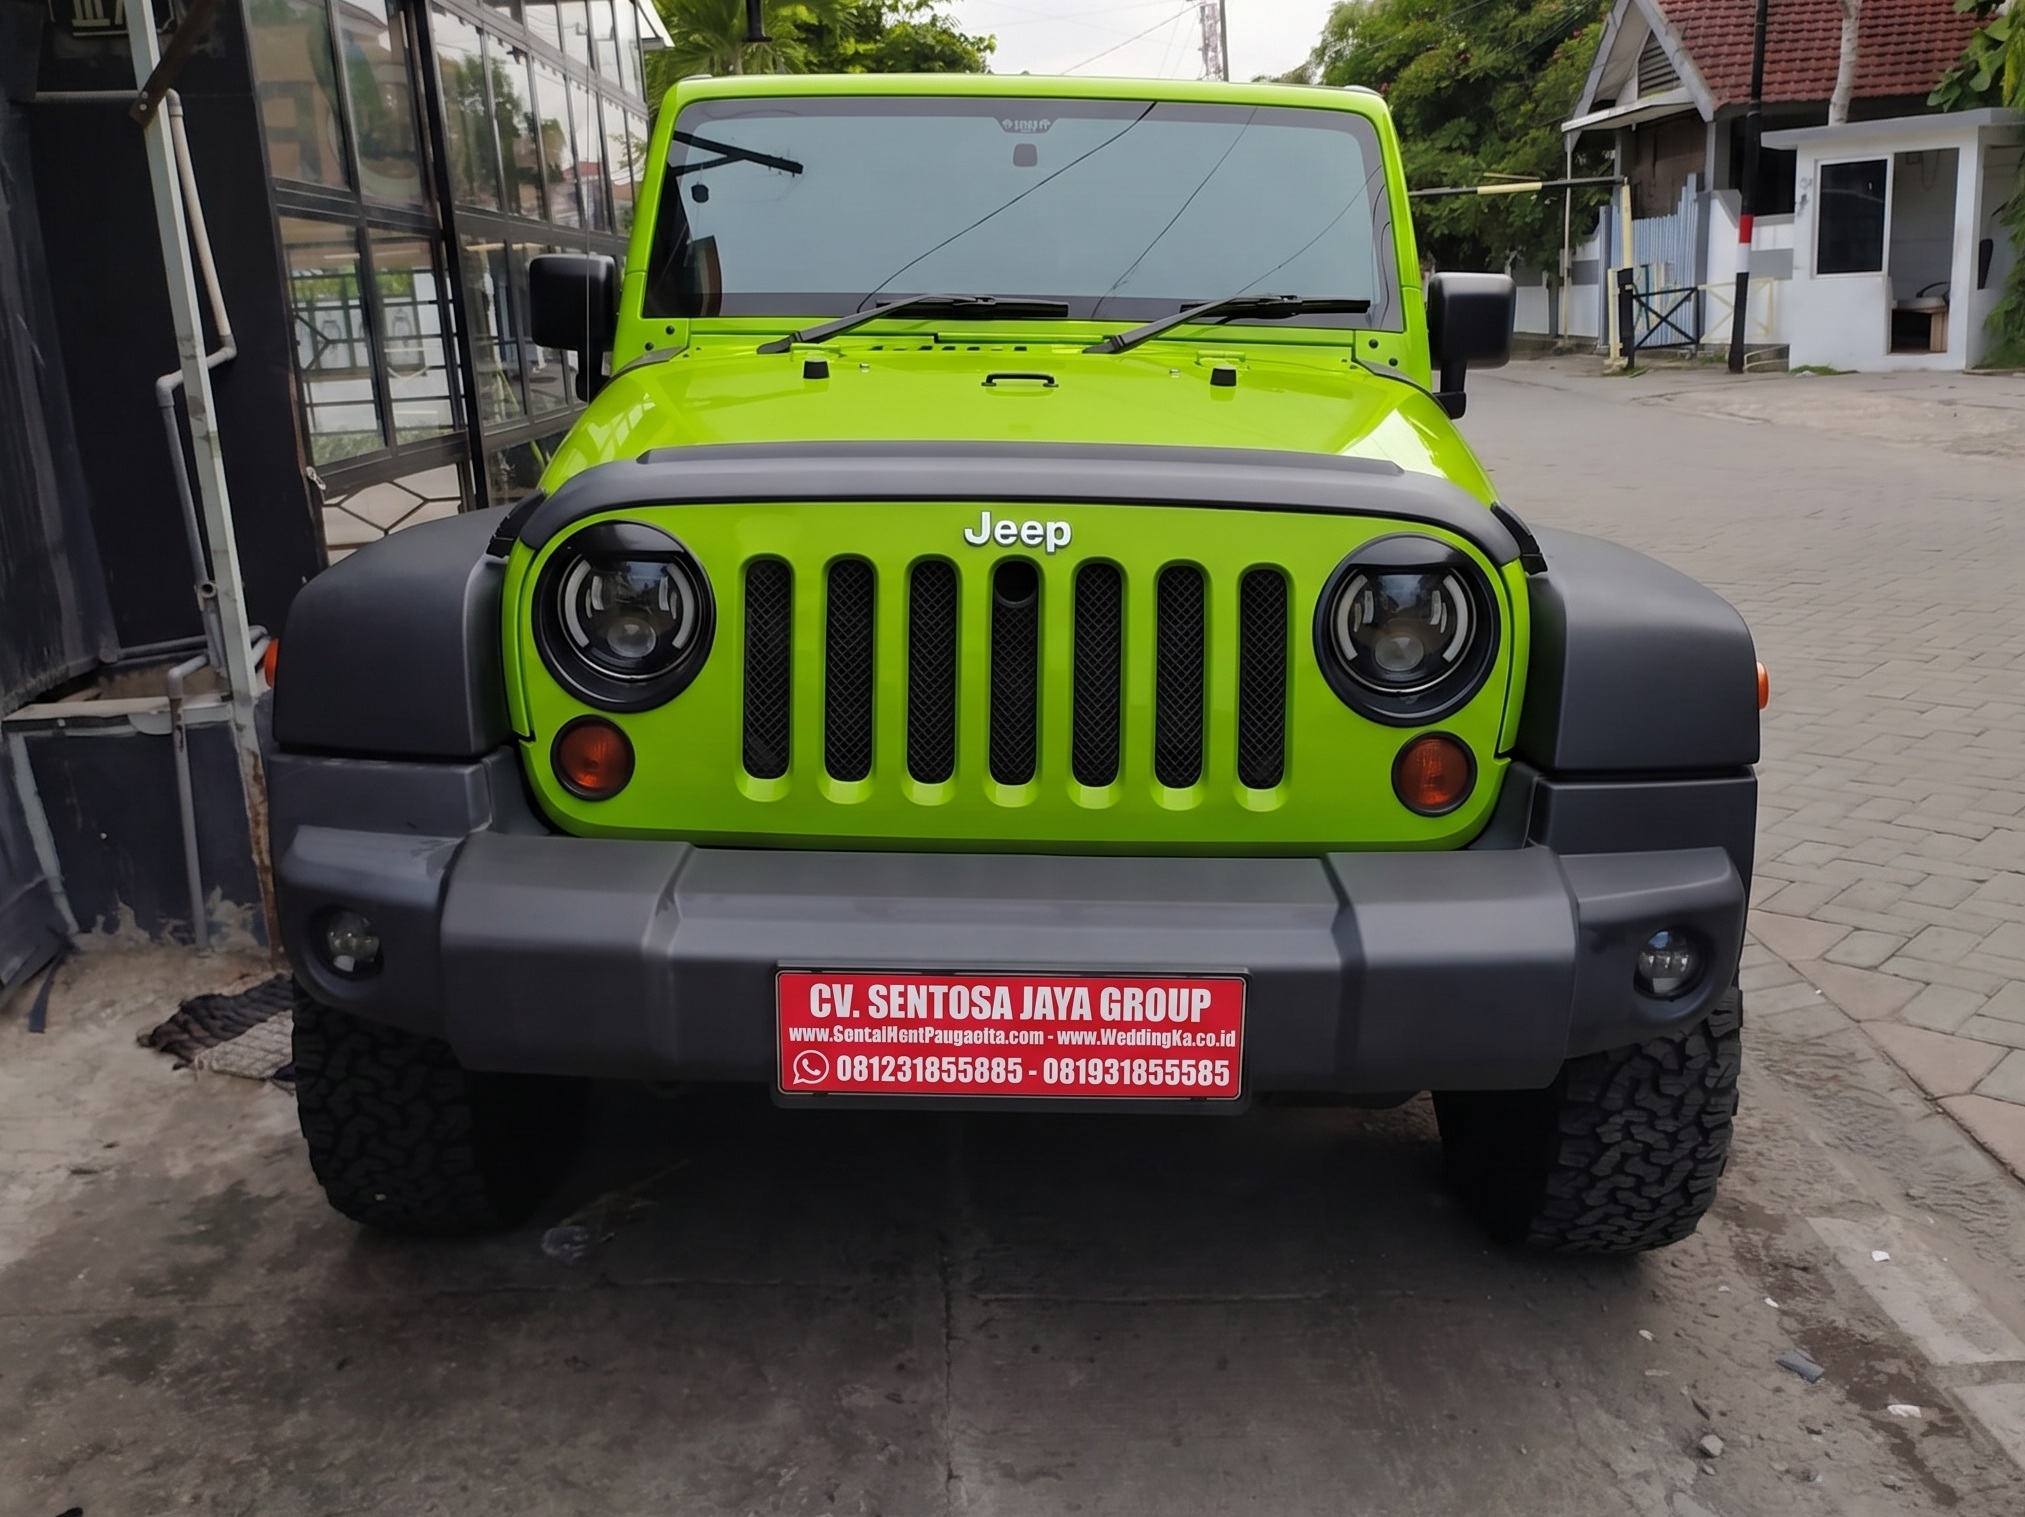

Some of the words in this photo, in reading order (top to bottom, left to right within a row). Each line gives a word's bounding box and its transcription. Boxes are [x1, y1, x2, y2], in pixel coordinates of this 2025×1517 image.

[964, 511, 1072, 553] Jeep
[809, 983, 860, 1018] CV.
[868, 984, 1014, 1020] SENTOSA
[1019, 986, 1093, 1021] JAYA
[1099, 986, 1212, 1023] GROUP
[1057, 1028, 1236, 1049] www.WeddingKa.co.id
[836, 1055, 1023, 1084] 081231855885
[1043, 1057, 1230, 1086] 081931855585
